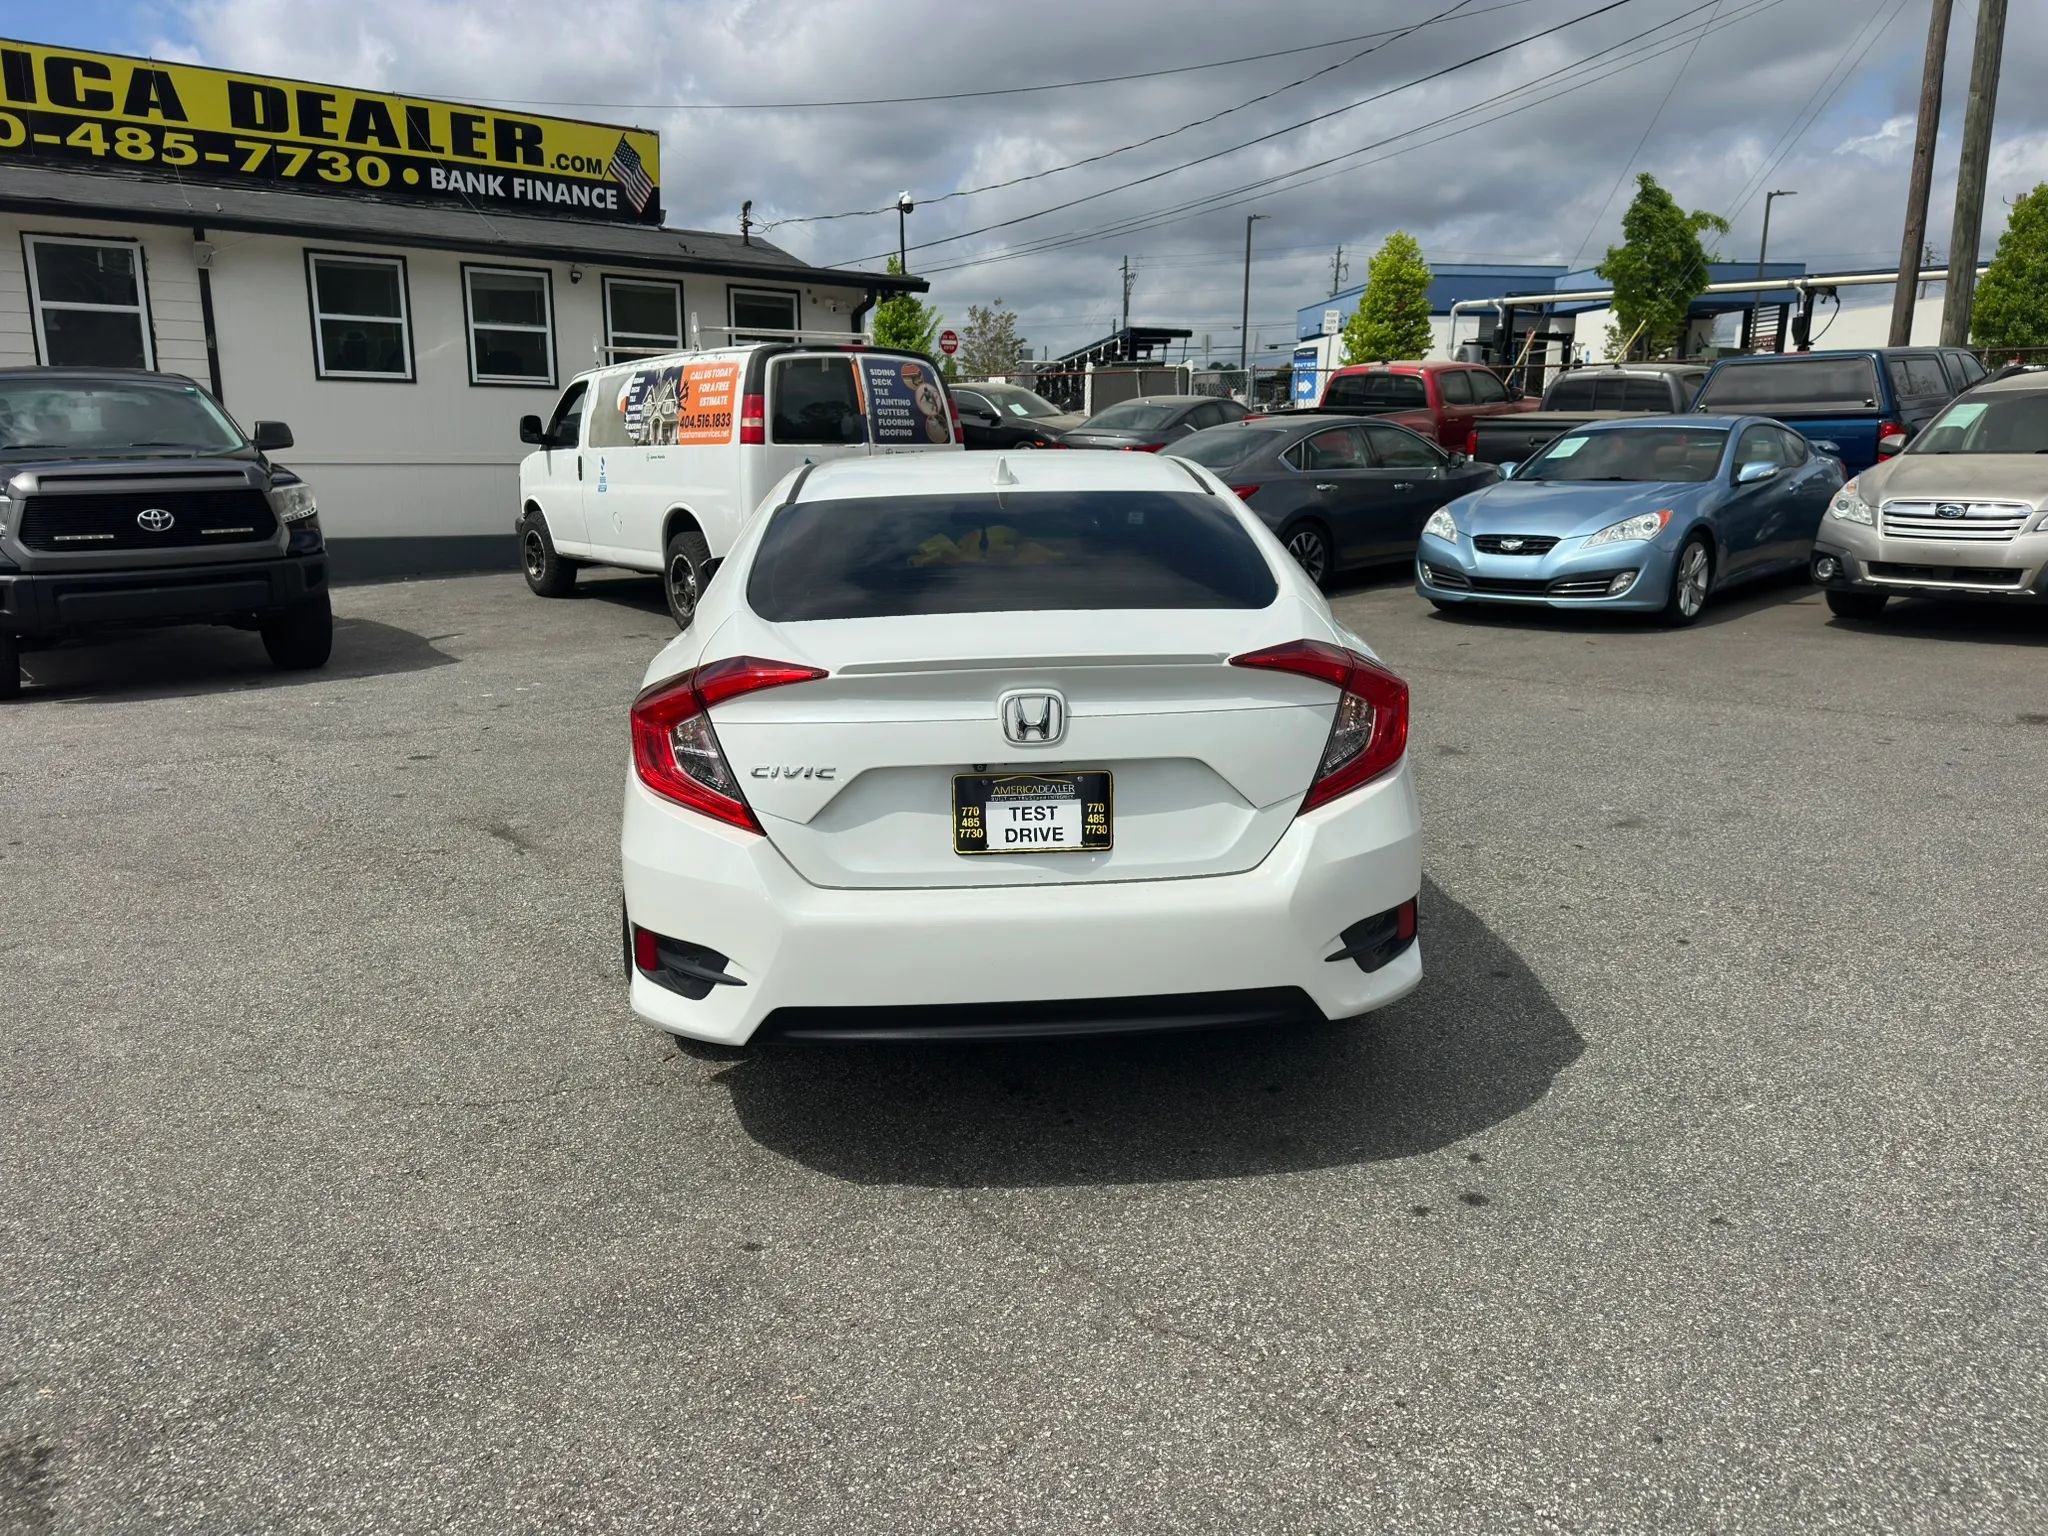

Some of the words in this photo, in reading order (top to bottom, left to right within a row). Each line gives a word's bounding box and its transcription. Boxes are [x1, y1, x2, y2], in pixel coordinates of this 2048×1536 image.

[430, 167, 506, 198] BANK
[513, 177, 618, 210] FINANCE
[690, 371, 704, 380] CALL
[712, 368, 733, 378] TODAY
[869, 368, 896, 377] SIDING
[698, 383, 710, 394] FOR
[715, 380, 731, 392] FREE
[872, 378, 893, 386] DECK
[874, 388, 889, 396] TILE
[699, 395, 729, 407] ESTIMATE
[875, 398, 911, 407] PAINTING
[877, 408, 910, 417] GUTTERS
[680, 412, 732, 429] 404.516.1833
[878, 418, 915, 427] FLOORING
[879, 428, 913, 437] ROOFING
[750, 765, 836, 780] CIVIC
[992, 784, 1075, 795] AMERICADEALER
[961, 806, 980, 817] 770
[1008, 805, 1058, 822] TEST
[1087, 803, 1105, 813] 770
[961, 817, 980, 828] 485
[1087, 814, 1105, 824] 485
[959, 828, 984, 839] 7730
[1004, 826, 1065, 843] DRIVE
[1084, 824, 1108, 835] 7730
